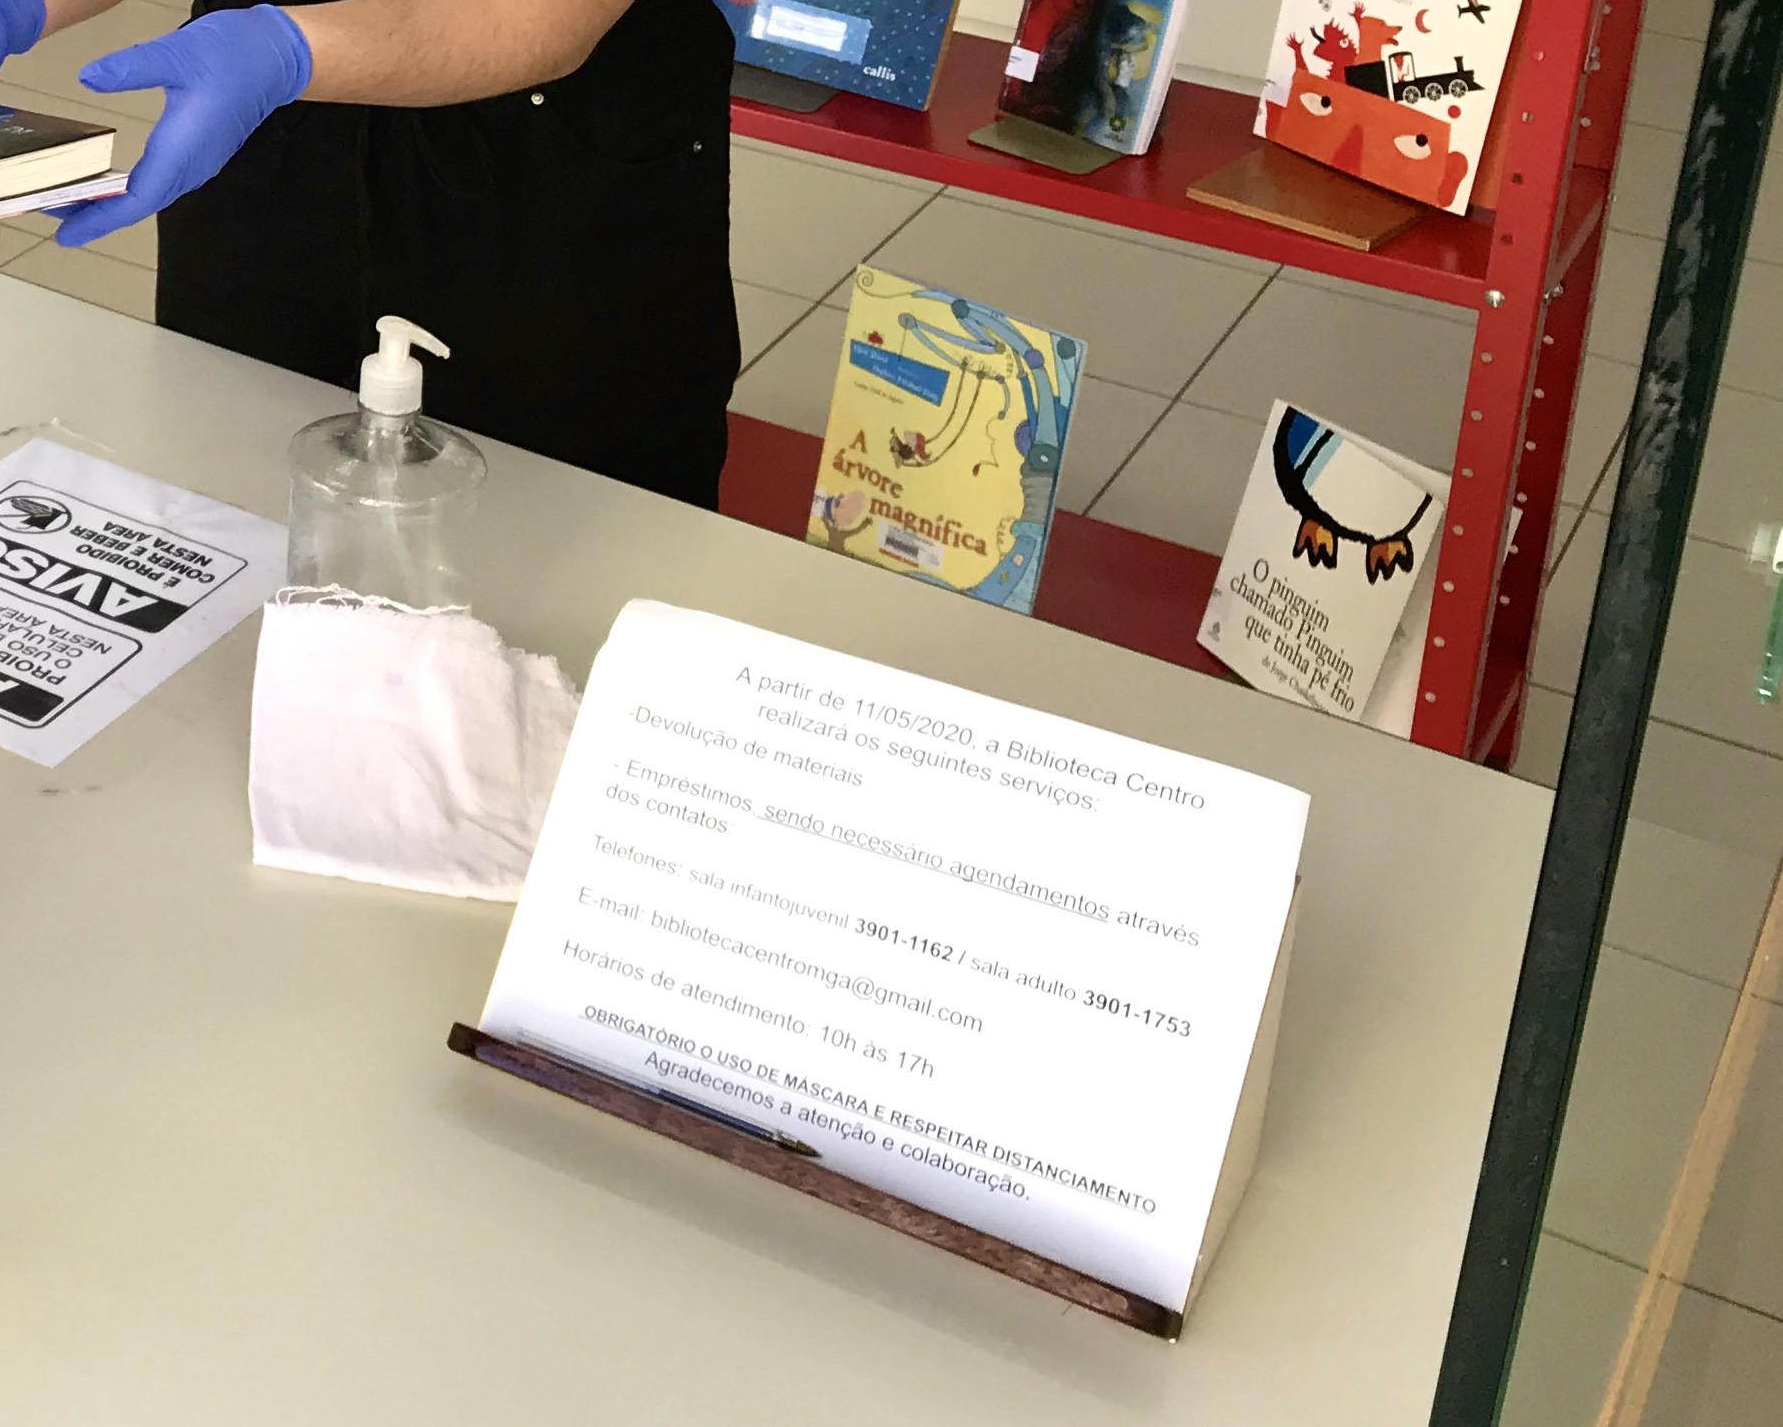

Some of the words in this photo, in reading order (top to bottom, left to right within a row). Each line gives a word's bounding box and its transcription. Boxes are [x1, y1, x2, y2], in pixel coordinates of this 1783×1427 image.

[862, 65, 897, 82] callis
[849, 428, 867, 454] A
[831, 447, 904, 500] árvore
[69, 524, 130, 551] BEBER
[130, 546, 147, 557] E
[152, 536, 215, 568] NESTA
[868, 496, 988, 557] magnífica
[75, 543, 160, 582] PROIBIDO
[146, 554, 216, 584] COMER
[1252, 557, 1270, 584] O
[1267, 576, 1331, 634] pinguim
[7, 640, 53, 664] USO
[49, 622, 113, 655] NESTA
[1229, 572, 1295, 633] chamado
[1295, 618, 1355, 684] Pinguim
[53, 657, 73, 671] O
[1244, 614, 1273, 644] que
[1272, 632, 1311, 675] tinha
[1306, 667, 1333, 691] pé
[1329, 679, 1356, 714] frio
[736, 666, 752, 685] A
[757, 675, 815, 702] partir
[818, 690, 846, 711] de
[855, 697, 977, 751] 11/05/2020,
[985, 738, 1000, 754] a
[1005, 740, 1118, 786] Biblioteca
[1126, 772, 1206, 811] Centro
[742, 738, 768, 760] de
[773, 748, 865, 788] materiais
[757, 702, 849, 742] realizará
[854, 731, 880, 752] os
[886, 739, 992, 782] seguintes
[998, 771, 1101, 813] serviços:
[605, 782, 641, 807] dos
[764, 802, 826, 835] sendo
[830, 821, 944, 871] necessário
[949, 858, 1111, 921] agendamentos
[1116, 908, 1201, 948] através
[578, 885, 645, 923] E-mail:
[650, 909, 984, 1033] bibliotecacentromga@gmail.com
[593, 834, 683, 877] Telefones:
[688, 867, 726, 891] sala
[730, 880, 850, 930] infantojuvenil
[854, 917, 954, 963] 3901-1162
[970, 955, 1010, 981] sala
[1015, 970, 1078, 1002] adulto
[1082, 989, 1192, 1039] 3901-1753
[562, 938, 646, 983] Horários
[650, 969, 676, 992] de
[680, 981, 811, 1036] atendimento:
[820, 1024, 858, 1053] 10h
[862, 1037, 889, 1063] às
[897, 1050, 935, 1079] 17h
[583, 1004, 697, 1055] OBRIGATÓRIO
[700, 1044, 714, 1060] O
[716, 1050, 753, 1074] USO
[756, 1062, 780, 1085] DE
[783, 1070, 870, 1115] MÁSCARA
[873, 1103, 886, 1119] E
[889, 1109, 990, 1155] RESPEITAR
[991, 1145, 1157, 1215] DISTANCIAMENTO
[643, 1050, 775, 1112] Agradecemos
[779, 1100, 794, 1116] a
[796, 1105, 877, 1146] atenção
[881, 1135, 896, 1152] e
[899, 1141, 1032, 1202] colaboração.
